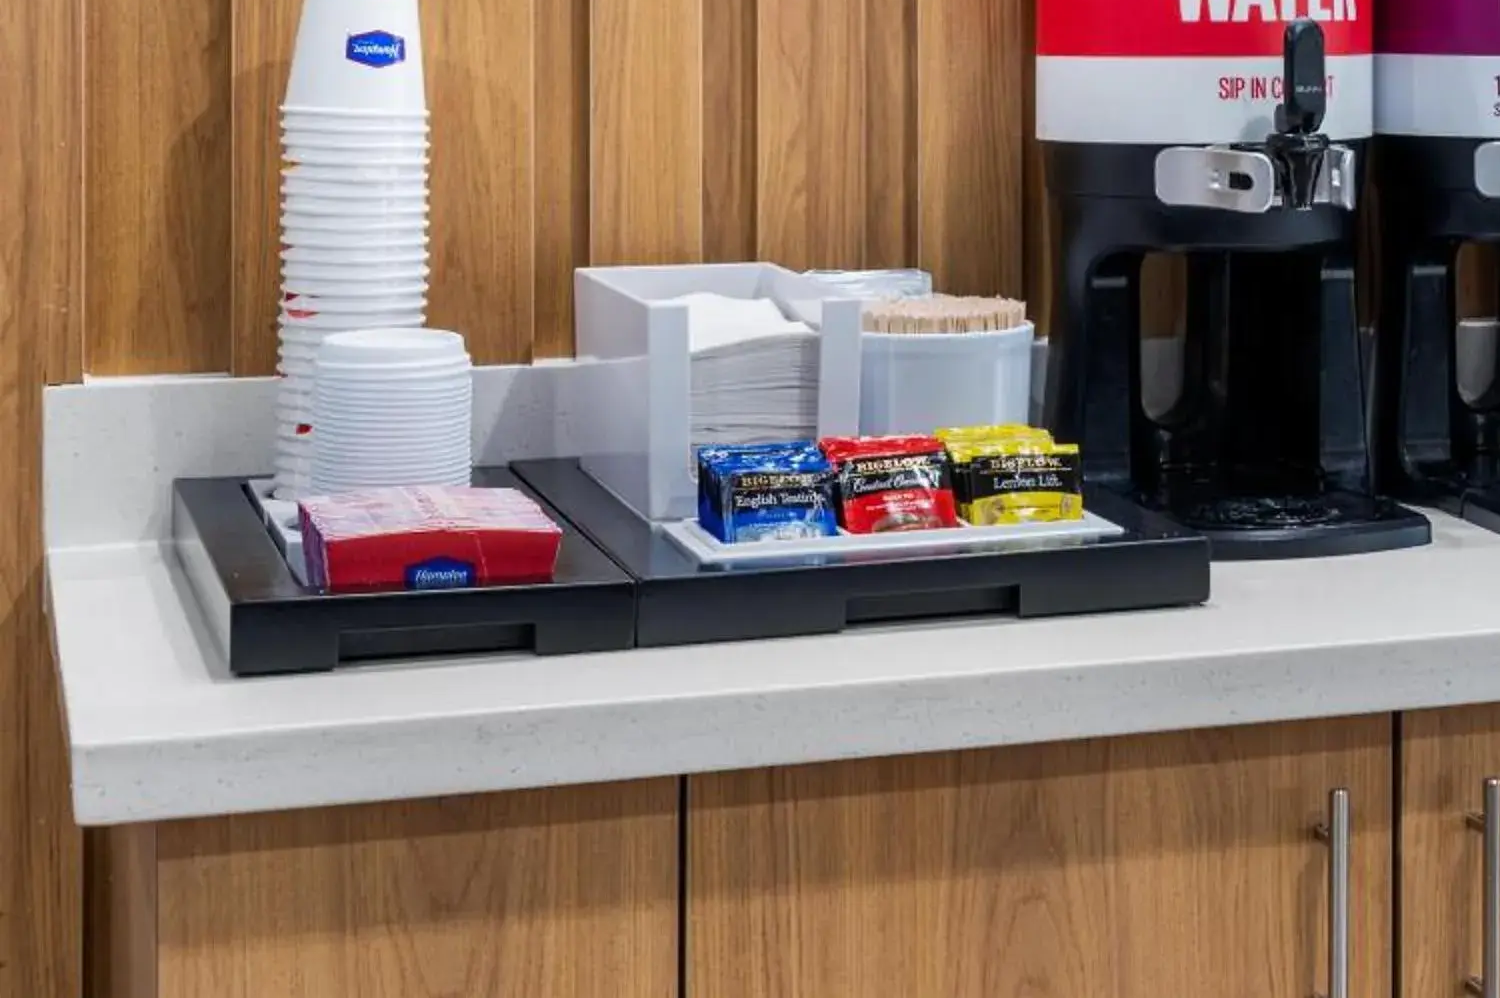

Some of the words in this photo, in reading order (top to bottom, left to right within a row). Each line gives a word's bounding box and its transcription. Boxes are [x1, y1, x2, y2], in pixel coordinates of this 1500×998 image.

[1218, 77, 1246, 99] SIP
[1251, 77, 1267, 99] IN
[735, 493, 777, 509] English
